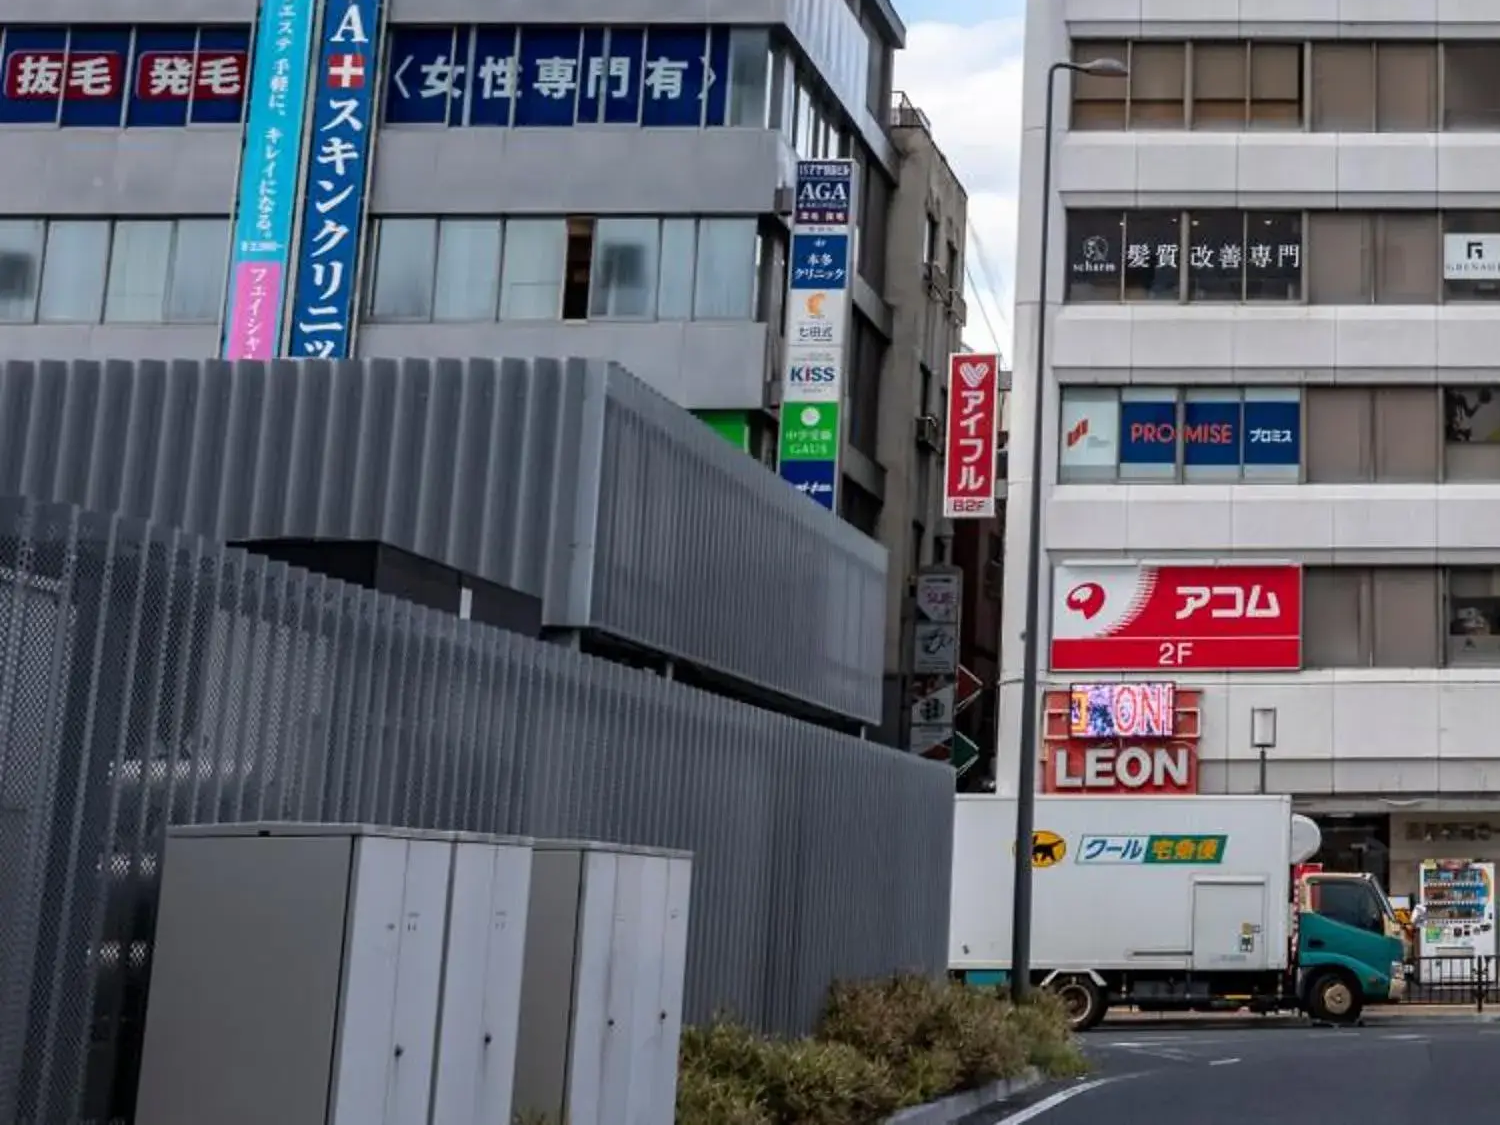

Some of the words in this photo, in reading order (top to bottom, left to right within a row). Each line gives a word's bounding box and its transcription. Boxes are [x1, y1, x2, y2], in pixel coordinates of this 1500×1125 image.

[16, 56, 112, 96] 抜毛
[149, 57, 240, 95] 発毛
[799, 182, 847, 200] AGA
[1127, 243, 1300, 268] 髪質改善専門
[957, 390, 985, 492] アイフル
[1131, 422, 1233, 444] PROMISE
[1250, 428, 1292, 443] プロミス
[953, 499, 985, 512] B2F
[1175, 584, 1281, 620] アコム
[1158, 643, 1194, 665] 2F
[1055, 746, 1189, 787] LEON
